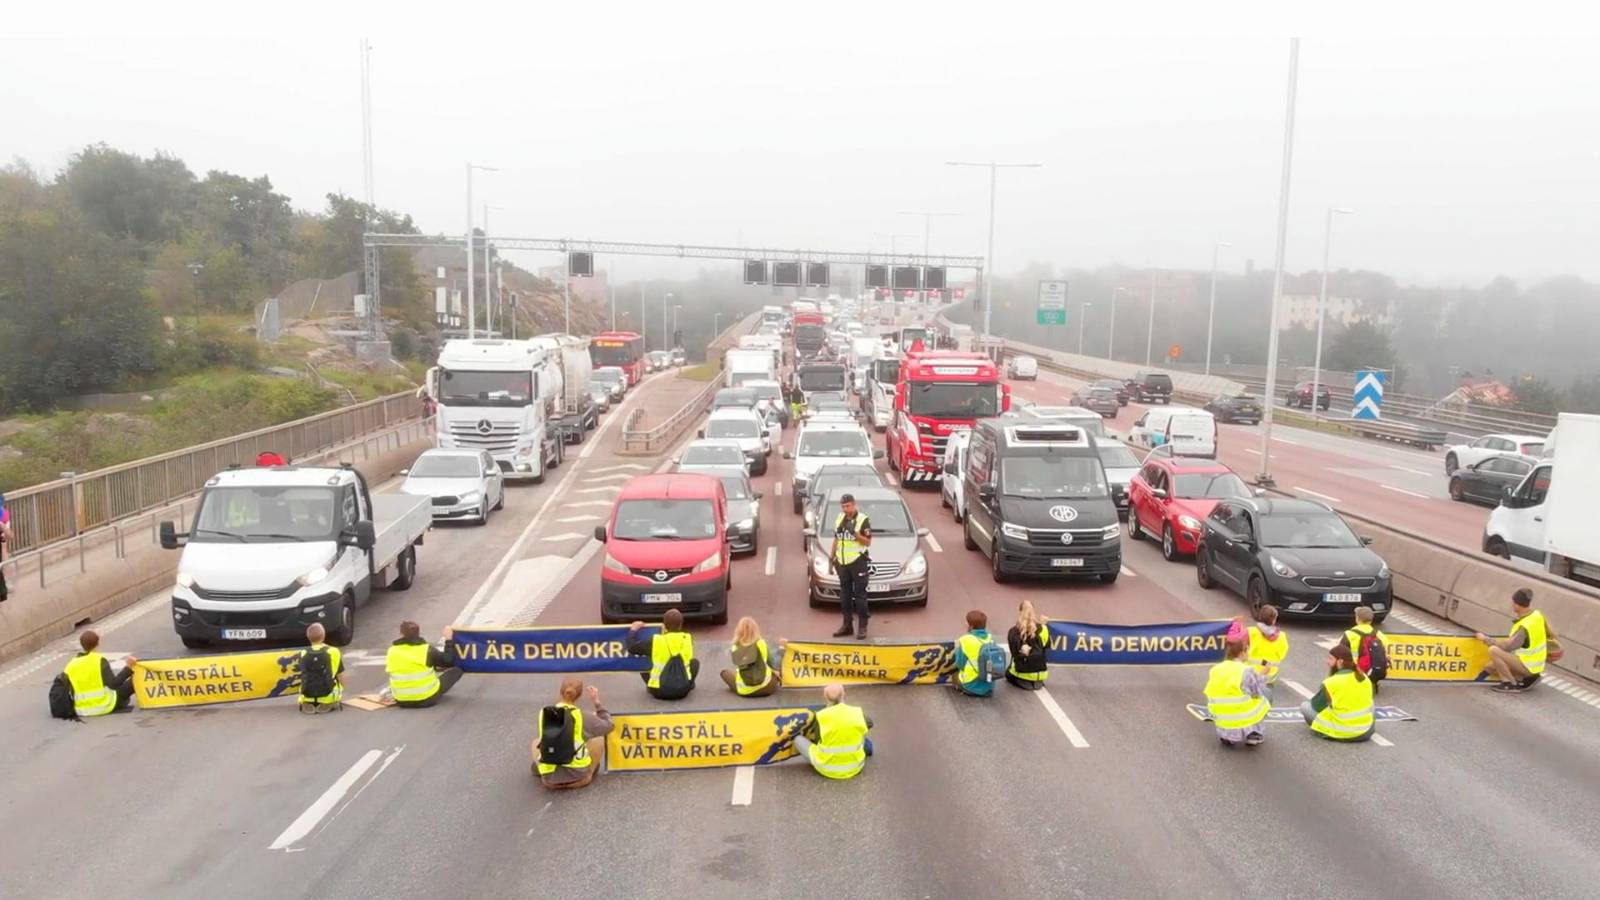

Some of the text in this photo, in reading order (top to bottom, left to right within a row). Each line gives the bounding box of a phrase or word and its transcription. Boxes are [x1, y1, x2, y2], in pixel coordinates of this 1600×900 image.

[246, 630, 262, 638] 609
[1050, 635, 1067, 650] VI
[1074, 632, 1103, 652] ÄR
[455, 643, 477, 659] VI
[484, 640, 516, 660] ÄR
[792, 651, 880, 665] ÅTERSTÄLL
[1387, 643, 1461, 657] TERSTÄLL
[792, 665, 887, 679] VÅTMARKER
[1386, 657, 1467, 672] ÅTMARKER
[144, 664, 242, 682] ÅTERSTÄLL
[146, 681, 253, 698] VÅTMARKER
[620, 720, 733, 740] ÅTERSTÄLL
[621, 743, 743, 759] VÅTMARKER
